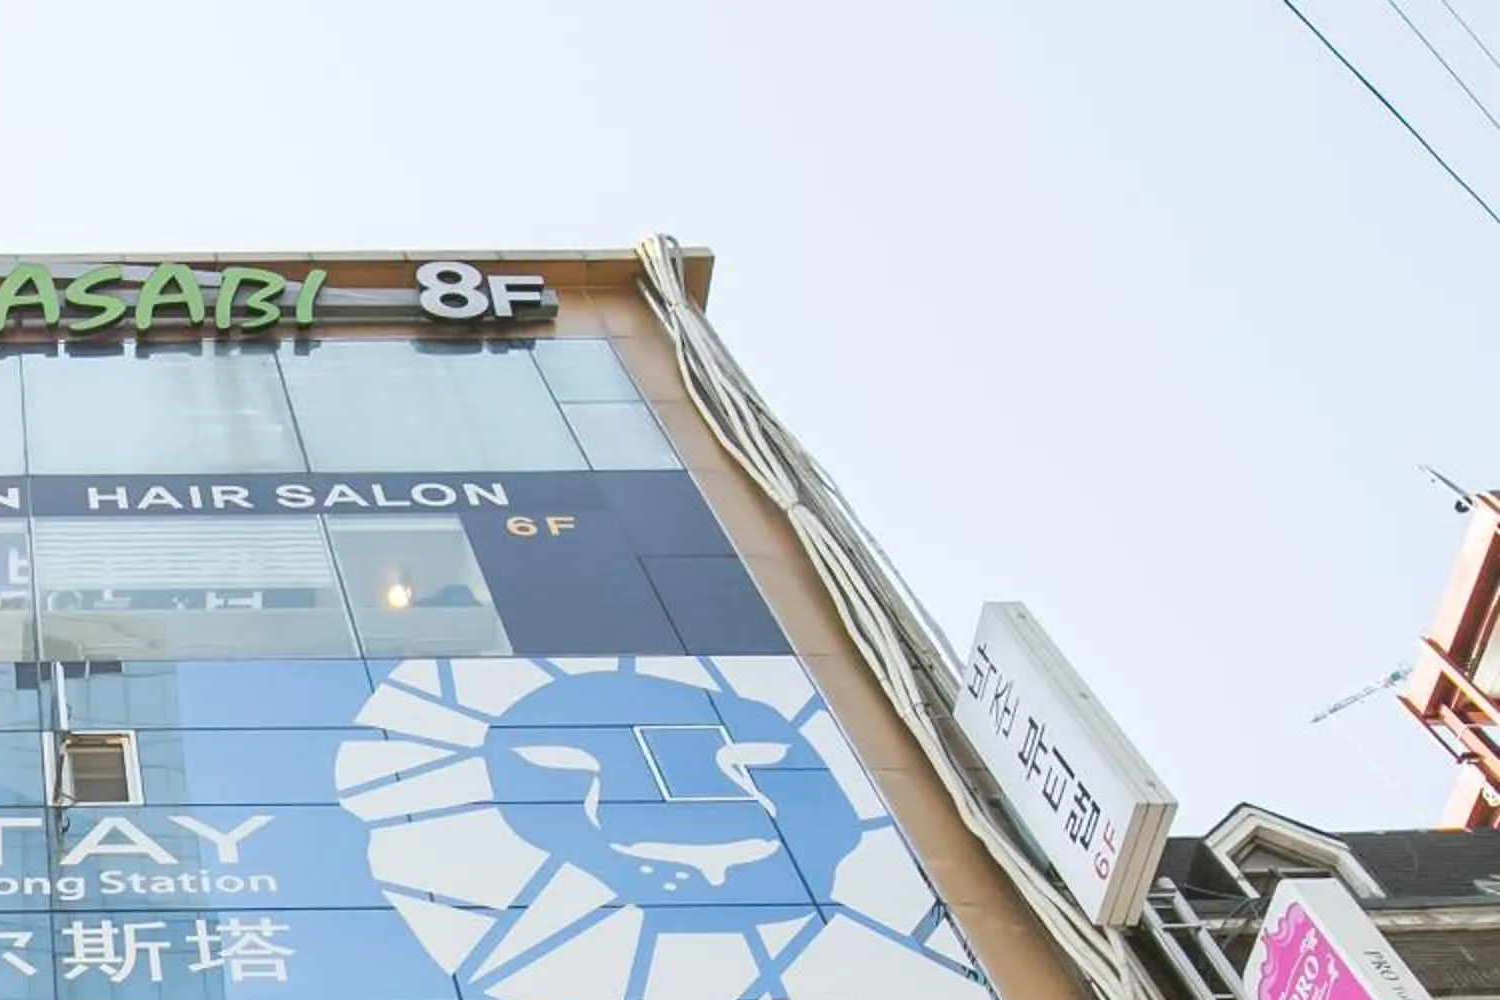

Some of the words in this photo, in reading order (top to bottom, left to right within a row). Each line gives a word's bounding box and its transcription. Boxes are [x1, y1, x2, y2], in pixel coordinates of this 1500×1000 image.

[415, 261, 545, 322] 8F
[86, 484, 253, 511] HAIR
[274, 482, 510, 508] SALON
[505, 515, 577, 538] 6F
[1093, 820, 1118, 881] 6F
[99, 866, 278, 897] Station
[1364, 950, 1400, 981] PRO
